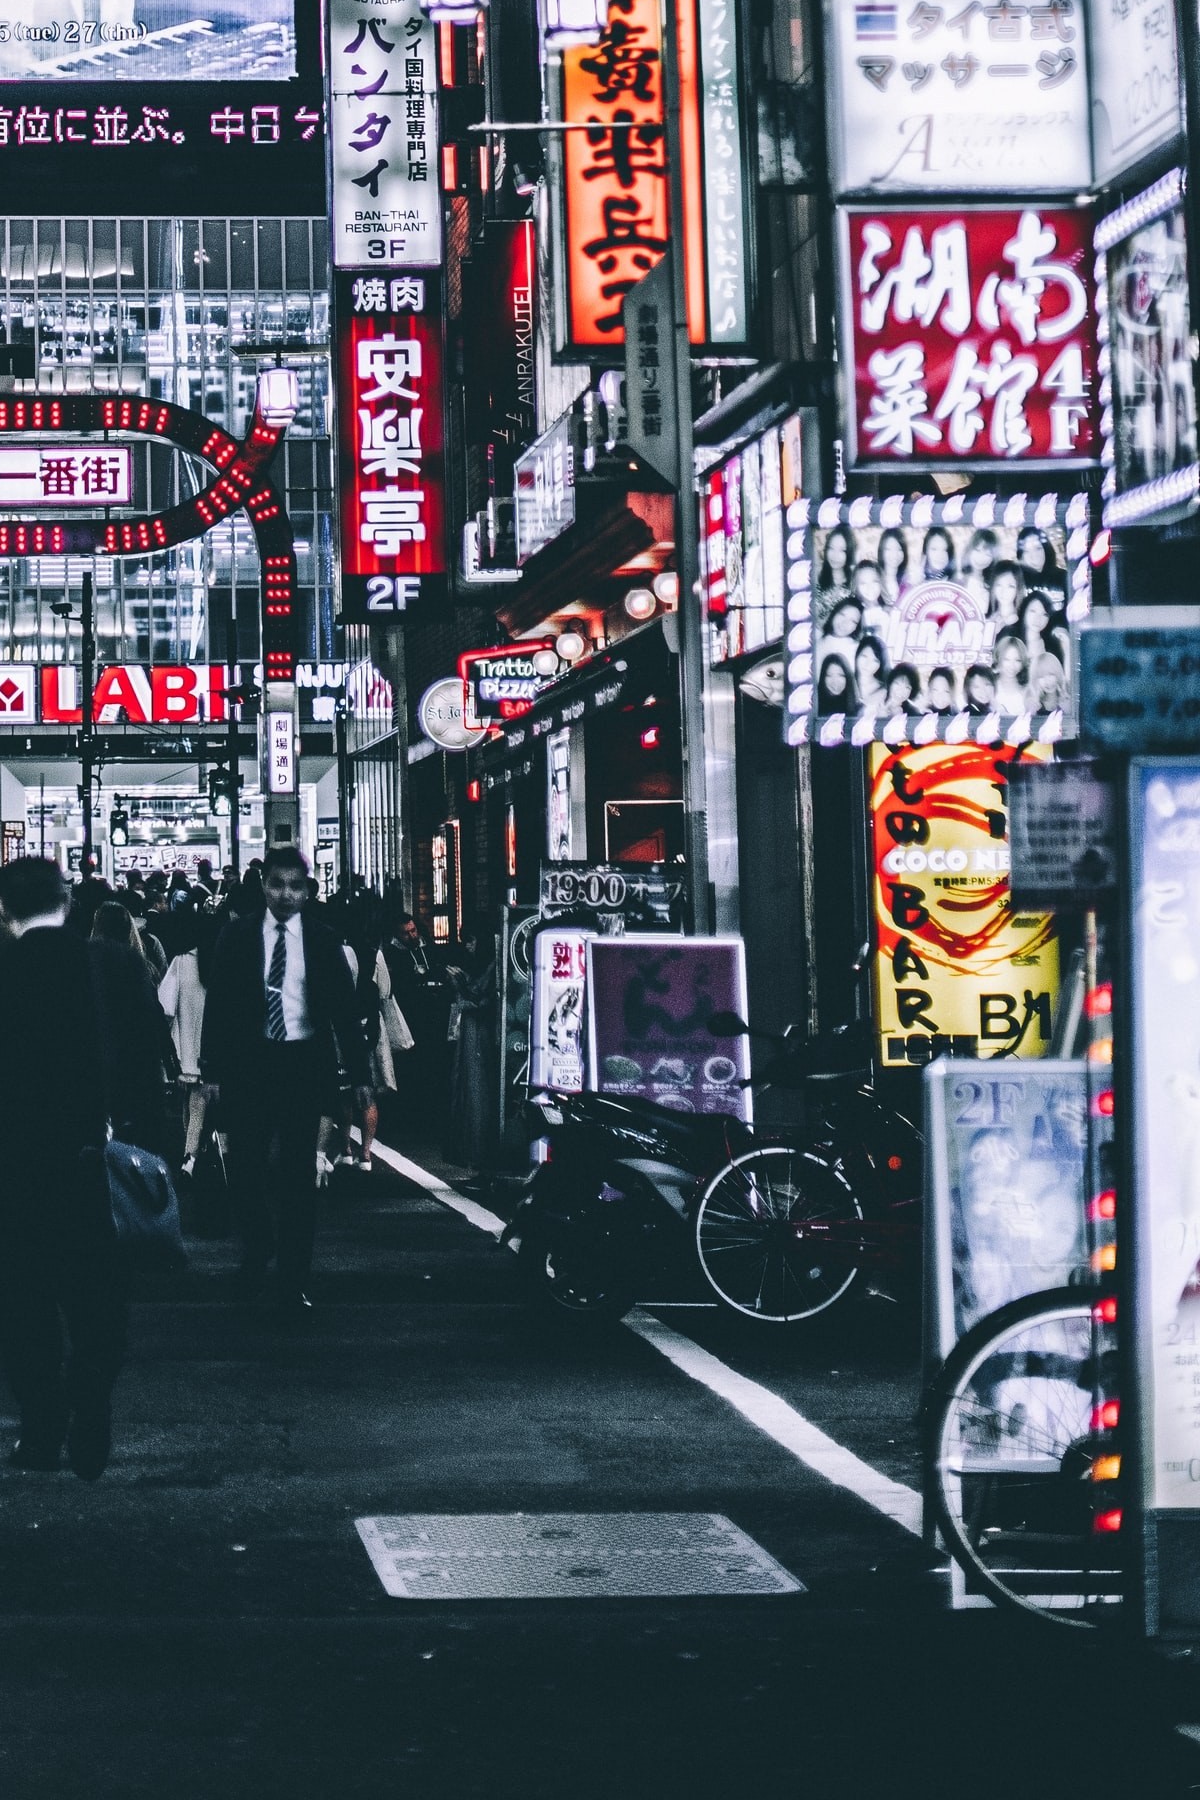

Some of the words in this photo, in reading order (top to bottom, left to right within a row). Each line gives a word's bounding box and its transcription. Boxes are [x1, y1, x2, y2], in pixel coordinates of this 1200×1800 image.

[856, 48, 1079, 93] マッサージ
[343, 16, 396, 198] バンタイ
[403, 16, 429, 183] タイ国料理専門店
[344, 221, 429, 234] RESTAURANT
[354, 209, 421, 221] BAN-THAI
[366, 238, 407, 260] 3F
[351, 276, 425, 314] 焼肉
[357, 332, 426, 557] 安楽亭
[365, 576, 422, 611] 2F
[41, 664, 242, 724] LABI
[275, 719, 289, 786] 劇場通り
[545, 871, 627, 907] 19:00
